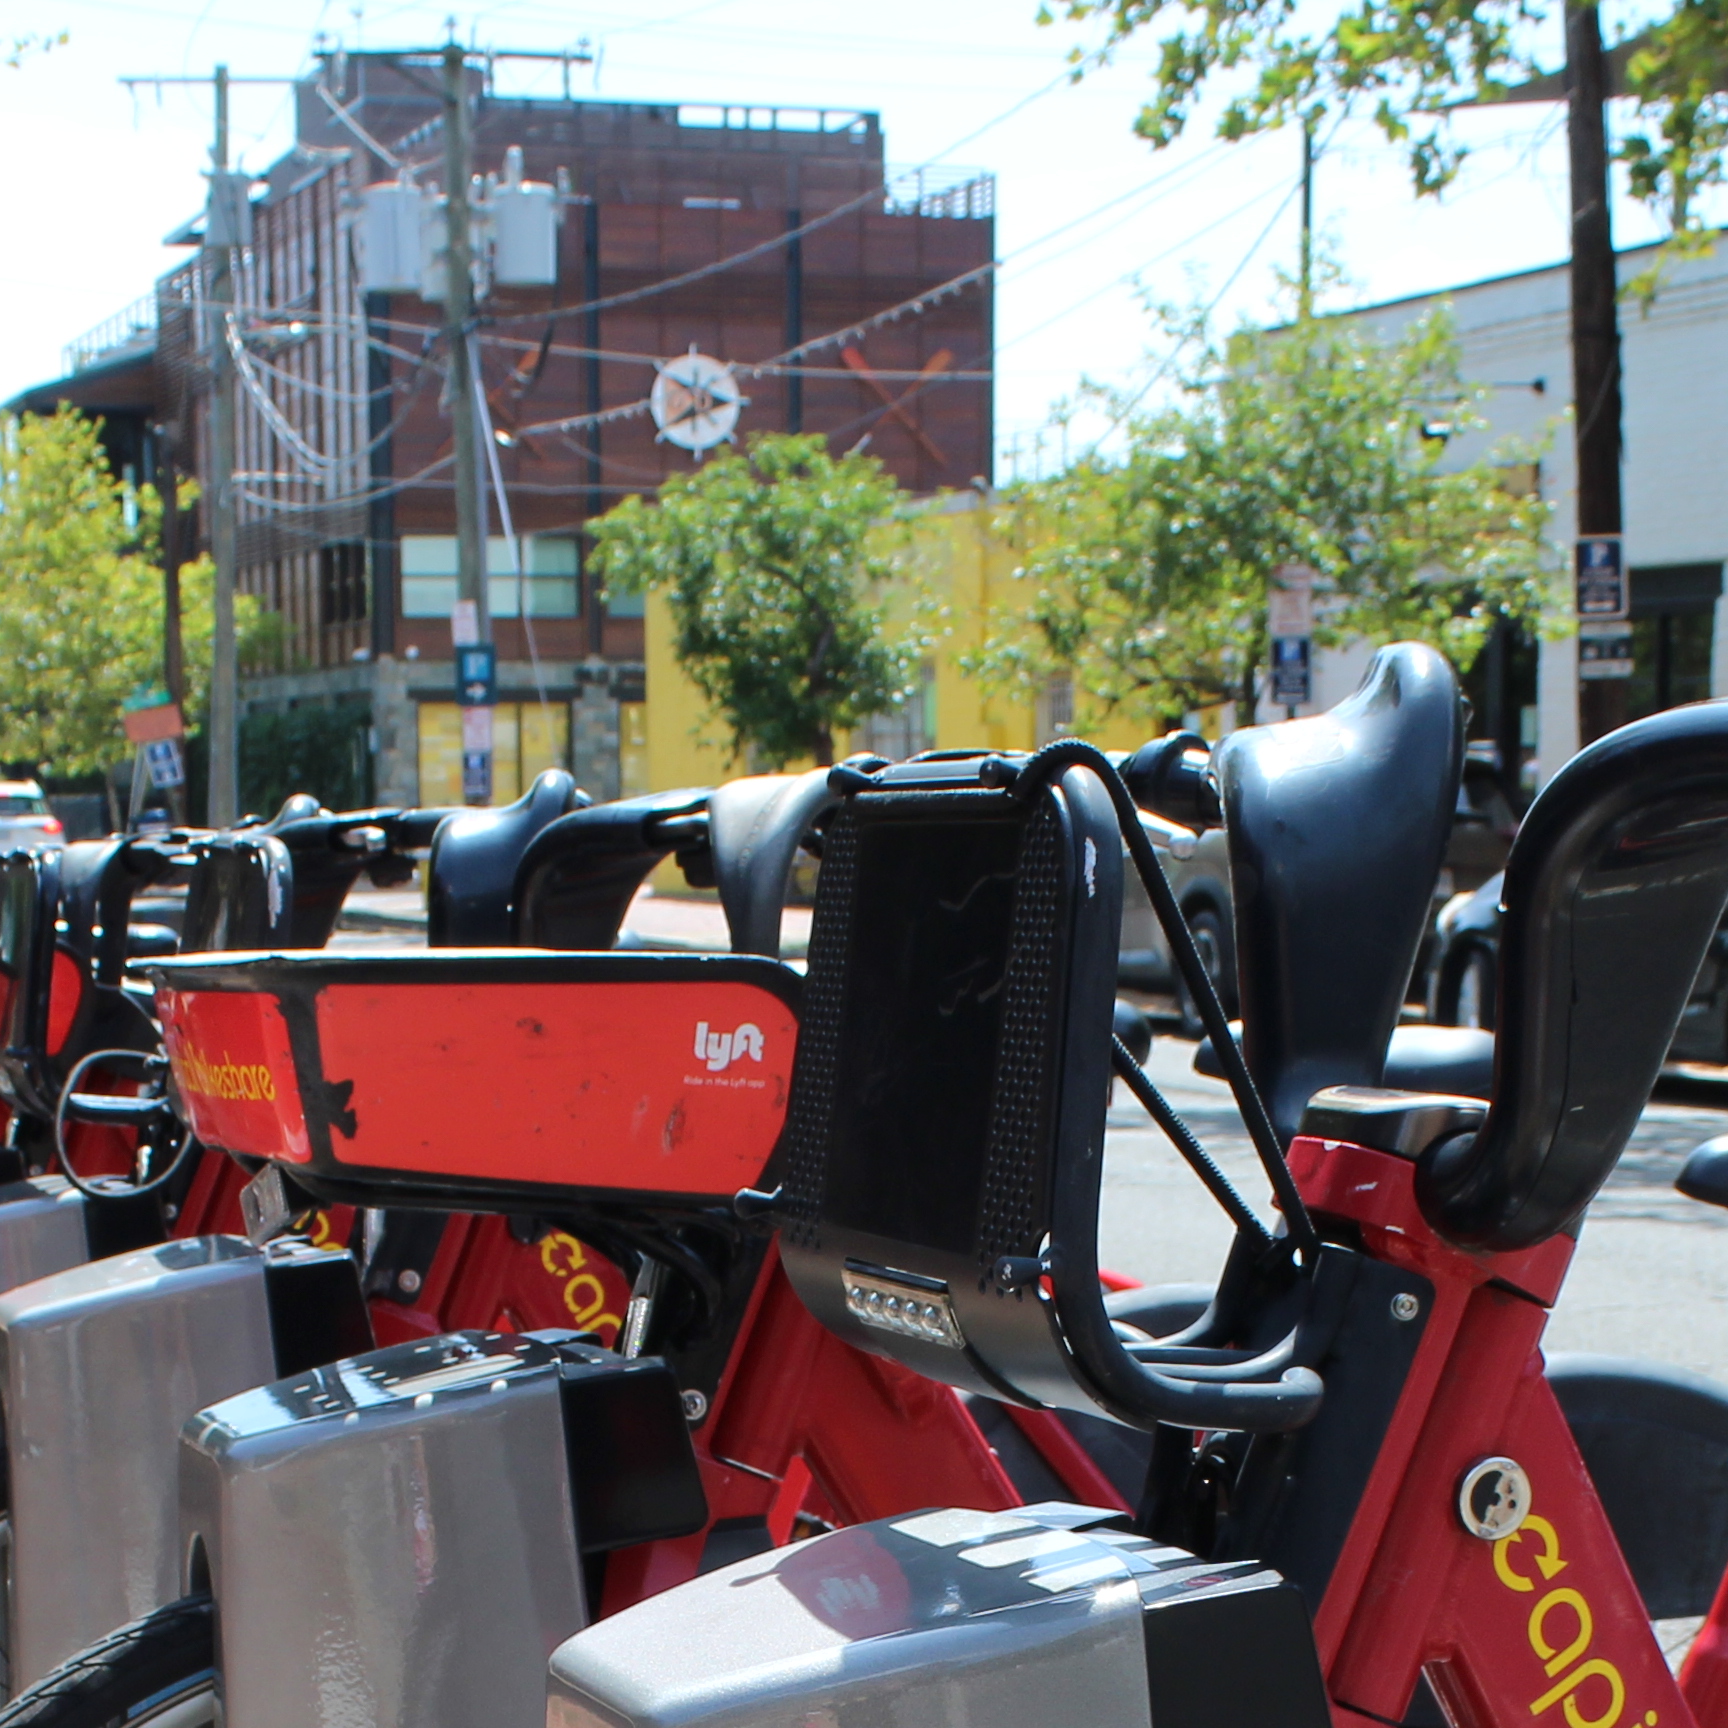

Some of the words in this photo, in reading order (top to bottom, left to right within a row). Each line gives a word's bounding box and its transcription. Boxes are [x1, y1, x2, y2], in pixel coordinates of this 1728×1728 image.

[683, 1075, 704, 1086] Ride
[705, 1077, 713, 1086] in
[714, 1077, 729, 1087] the
[730, 1078, 747, 1089] Lyft
[747, 1080, 766, 1089] app
